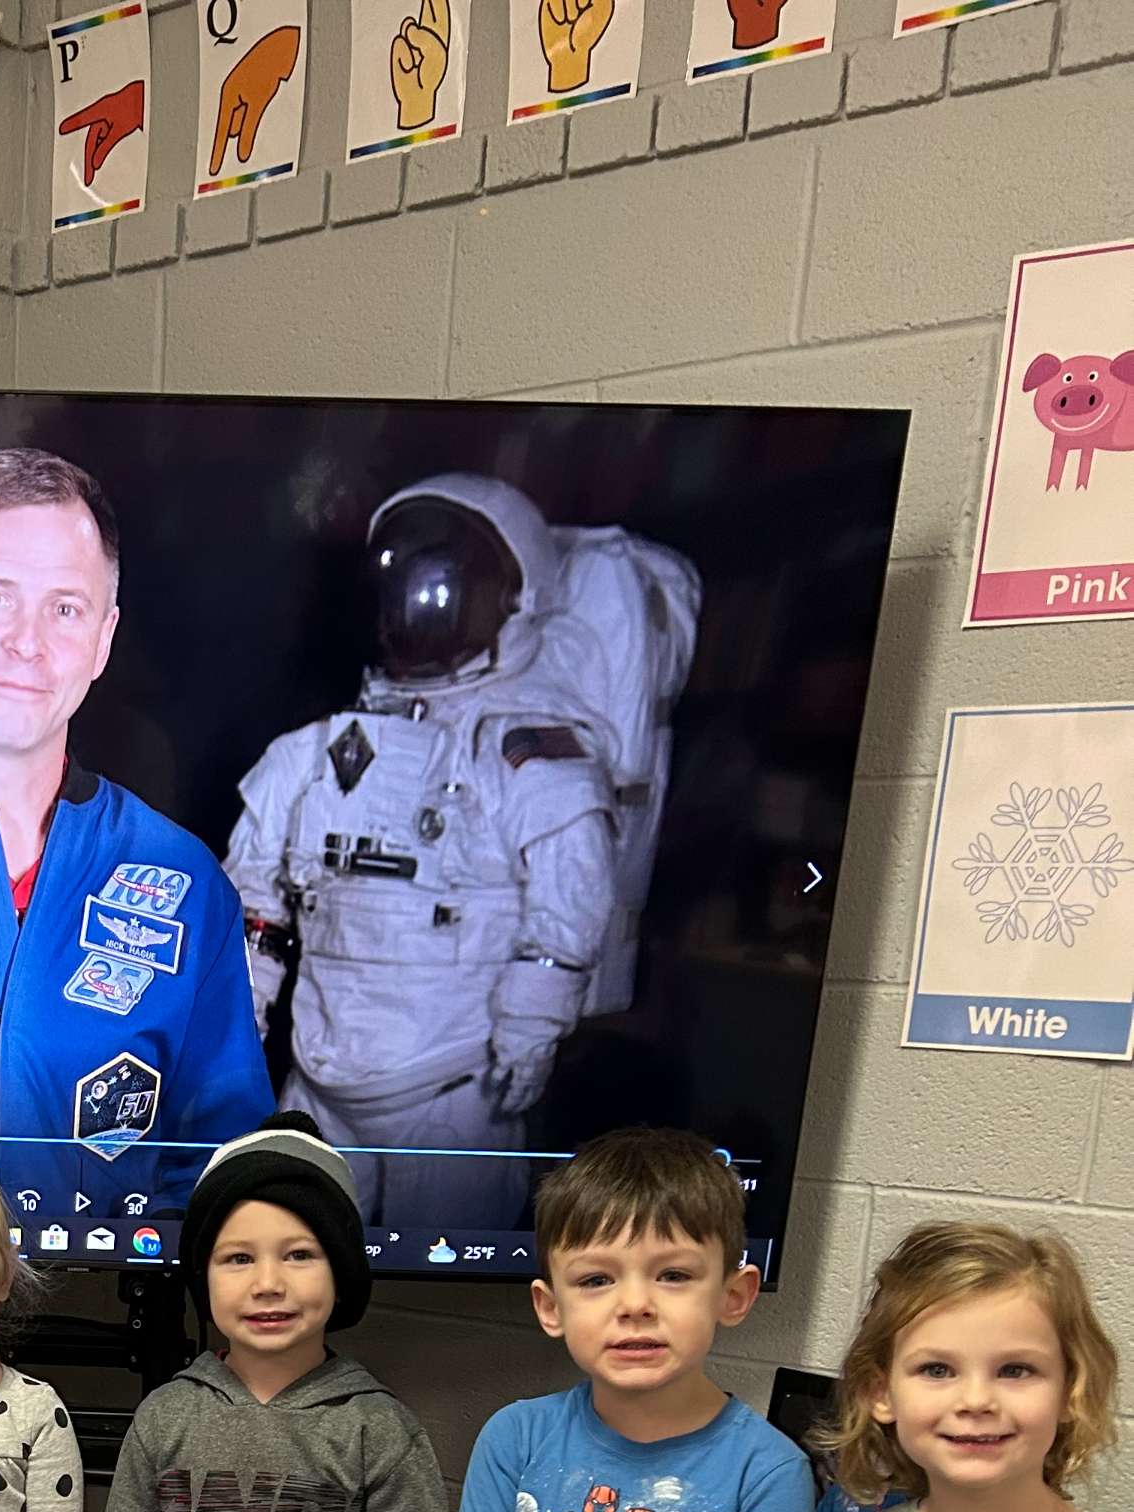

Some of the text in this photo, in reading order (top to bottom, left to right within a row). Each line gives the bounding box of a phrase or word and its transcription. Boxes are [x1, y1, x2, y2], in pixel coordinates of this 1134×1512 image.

[207, 0, 238, 47] Q
[57, 39, 79, 83] P
[1045, 571, 1132, 606] Pink
[105, 939, 156, 962] NICK HAGUE
[967, 1005, 1069, 1040] White
[22, 1199, 37, 1211] 10
[127, 1203, 143, 1215] 30
[463, 1246, 496, 1260] 25°F
